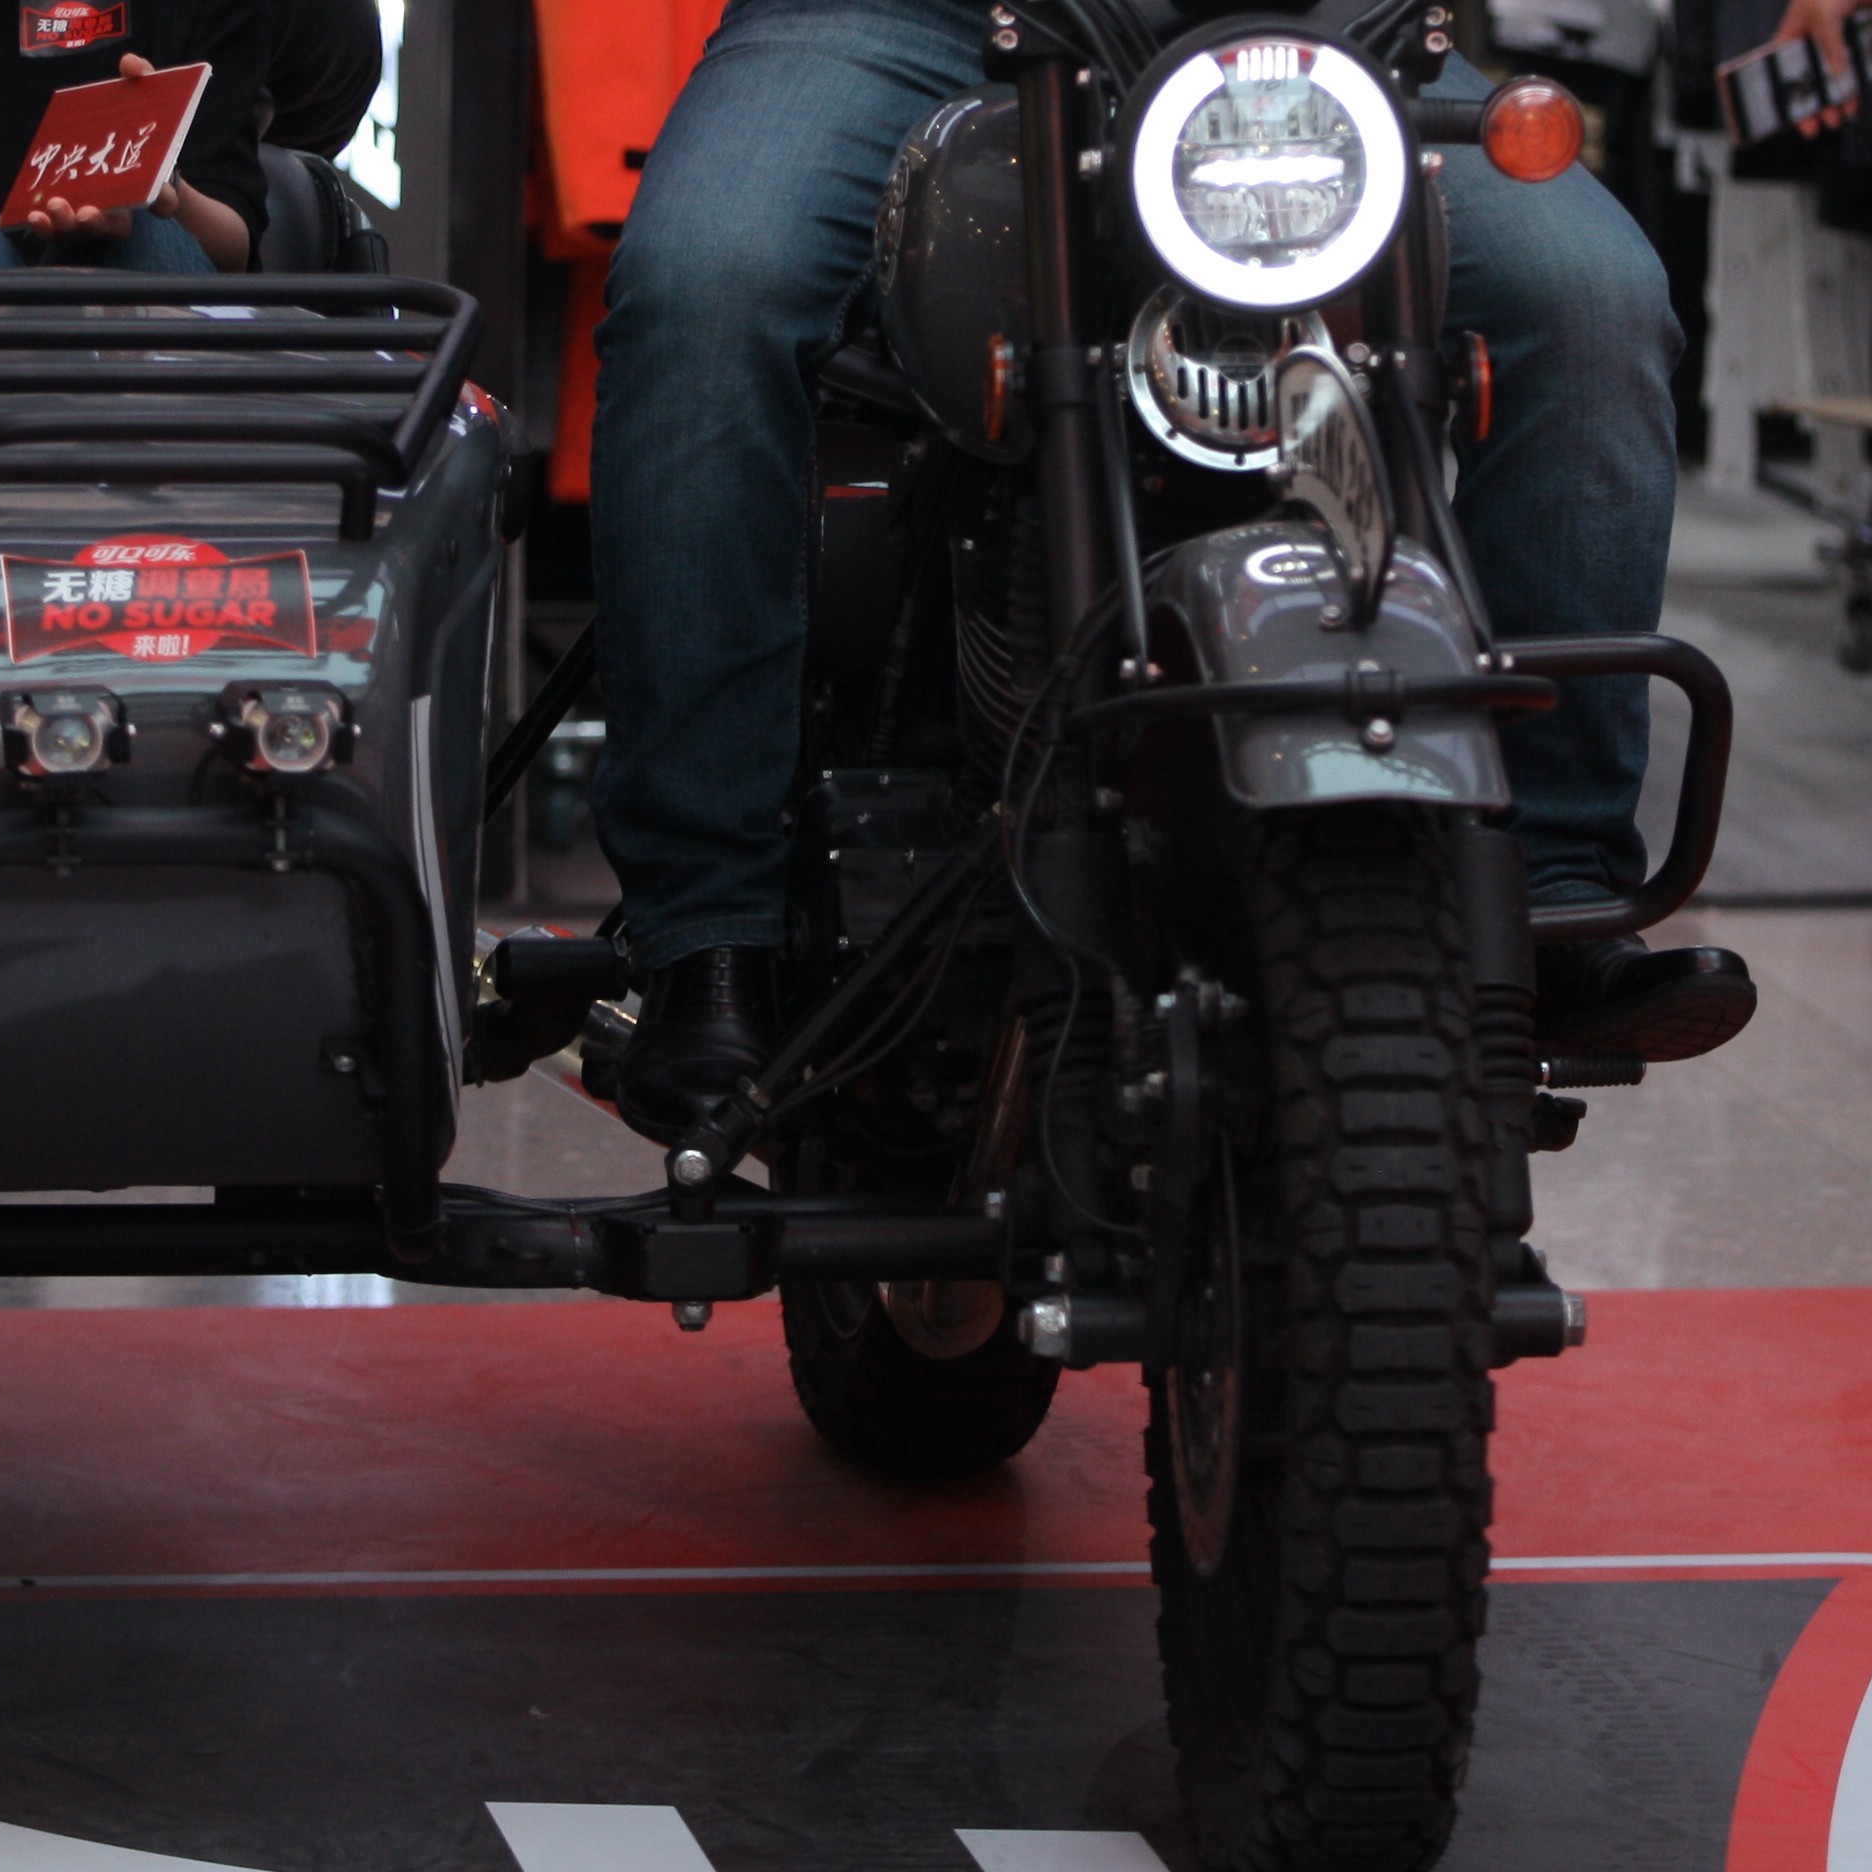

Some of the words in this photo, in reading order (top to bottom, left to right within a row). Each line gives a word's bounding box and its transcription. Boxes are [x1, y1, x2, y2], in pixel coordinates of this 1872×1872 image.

[42, 568, 272, 603] 无糖调查局
[41, 603, 113, 631] NO
[122, 600, 278, 628] SUGAR
